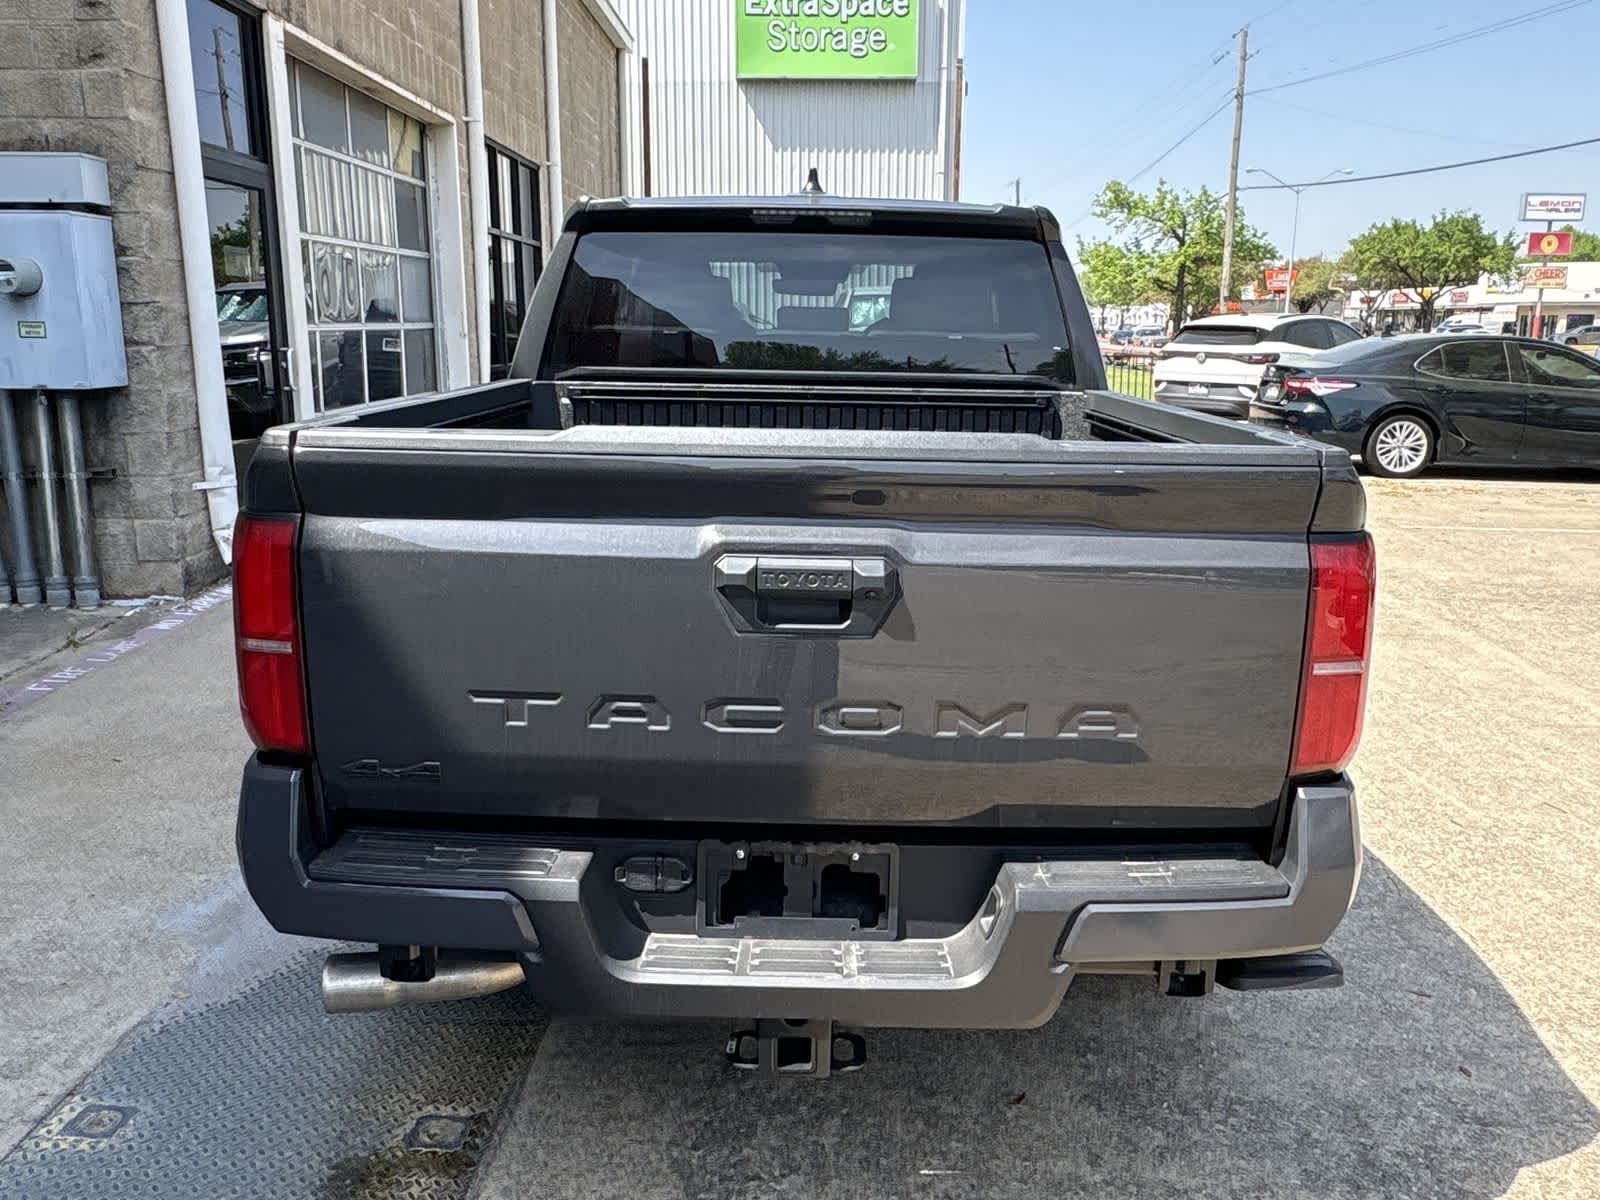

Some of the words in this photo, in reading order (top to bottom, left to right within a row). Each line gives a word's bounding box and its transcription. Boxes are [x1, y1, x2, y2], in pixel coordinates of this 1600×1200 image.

[767, 19, 887, 58] Storage
[761, 571, 849, 588] TOYOTA
[467, 689, 1142, 740] TACOMA
